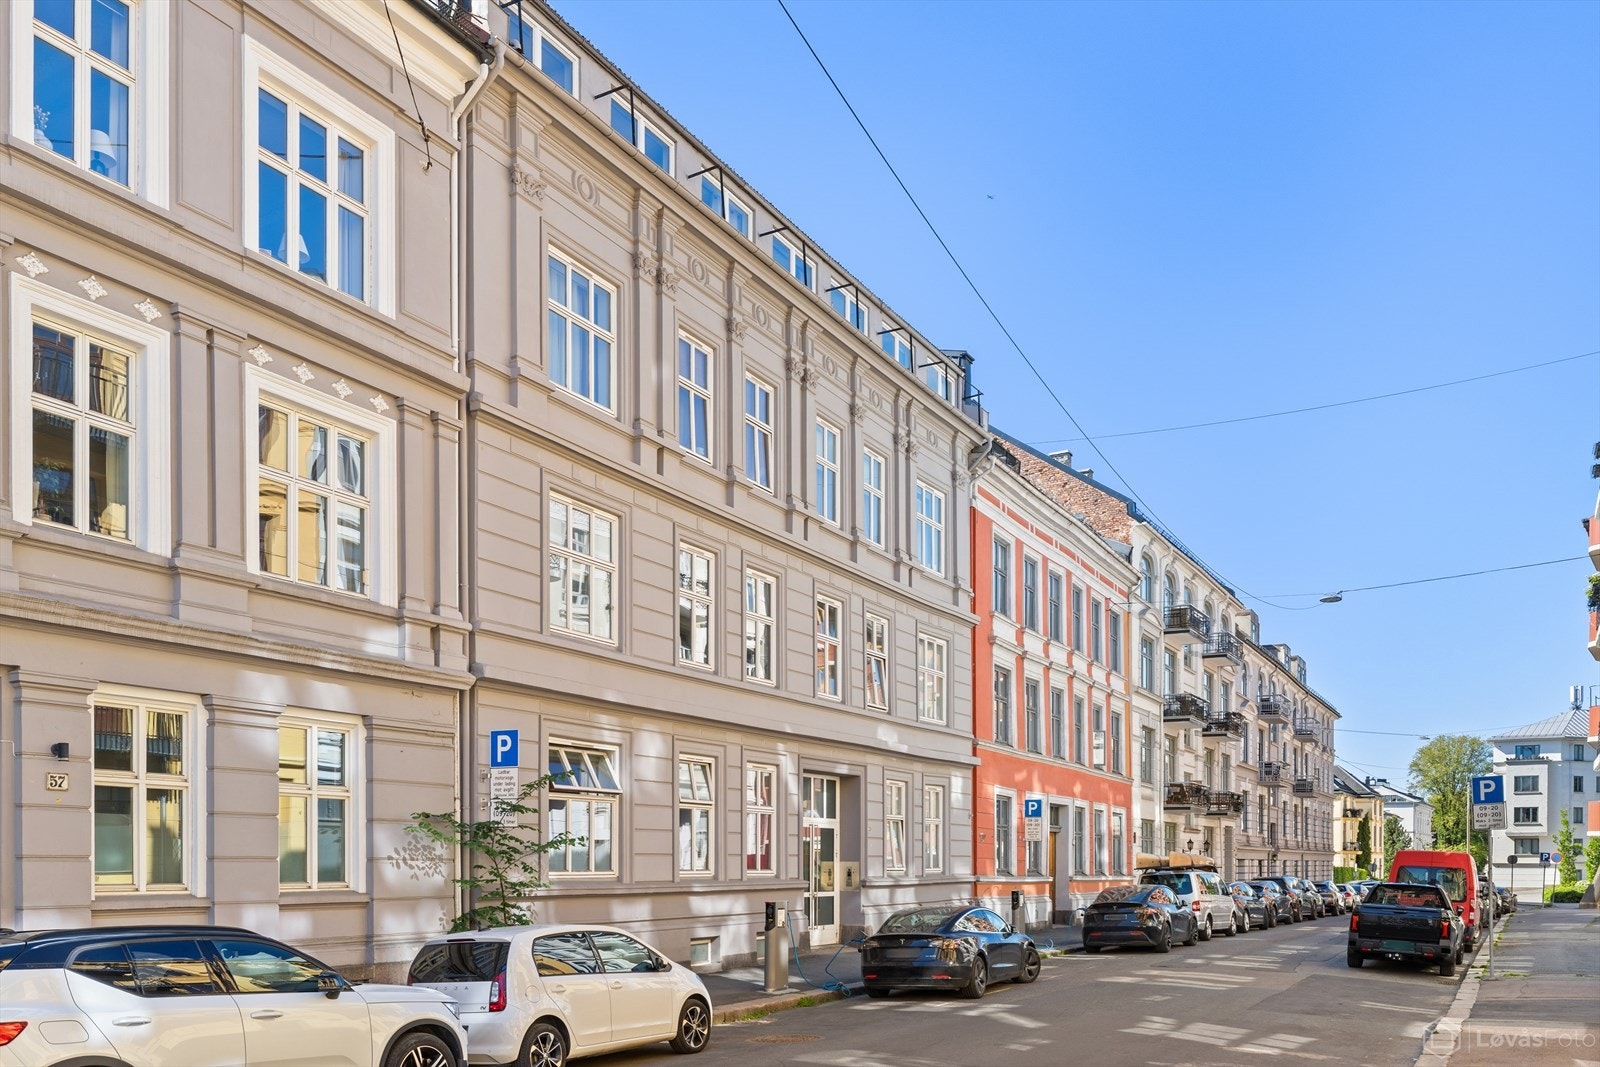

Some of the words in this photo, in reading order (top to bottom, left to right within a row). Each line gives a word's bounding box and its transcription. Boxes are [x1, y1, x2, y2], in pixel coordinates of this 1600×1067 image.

[497, 734, 512, 763] P
[49, 775, 66, 788] 57
[1480, 780, 1496, 801] P
[1028, 802, 1038, 816] P
[1542, 853, 1549, 861] P
